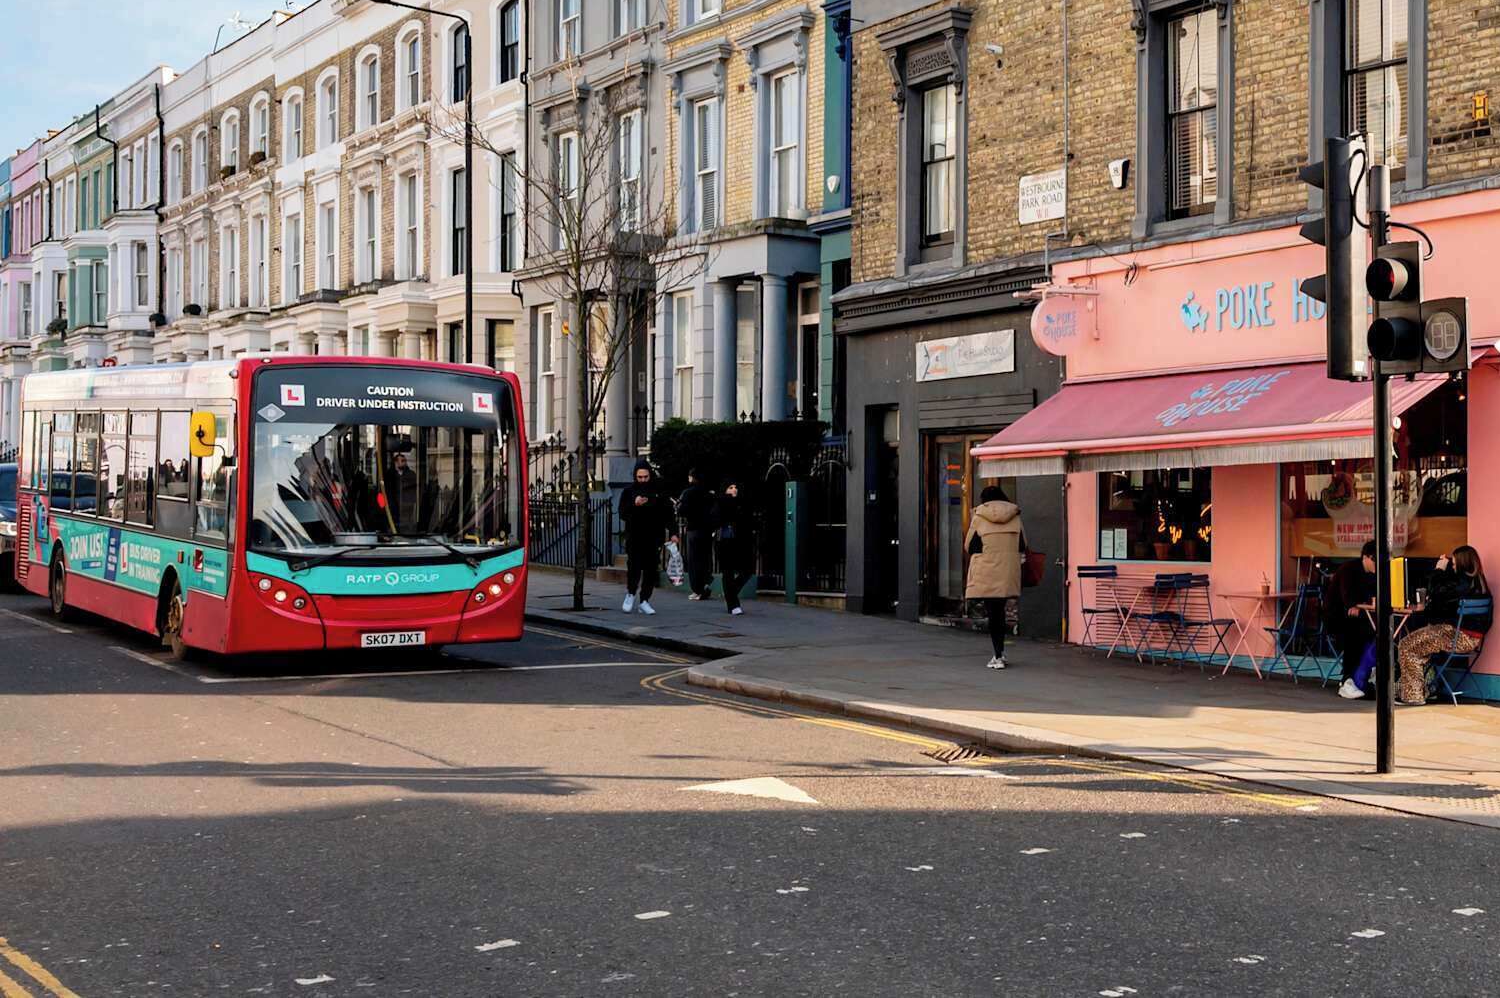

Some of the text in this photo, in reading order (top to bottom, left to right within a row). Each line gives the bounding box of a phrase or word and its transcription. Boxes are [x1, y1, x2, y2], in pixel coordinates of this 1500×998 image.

[1021, 178, 1064, 197] WESTBOURNE
[1021, 192, 1063, 210] PARK ROAD
[1216, 281, 1275, 331] POKE
[1056, 311, 1077, 325] POKE
[367, 386, 414, 396] CAUTION
[1212, 370, 1291, 398] POKE
[287, 389, 299, 401] L
[478, 396, 488, 408] L
[316, 397, 463, 412] DRIVER UNDER INSTRUCTION
[1155, 392, 1262, 427] HOUSE
[70, 535, 87, 561] JOIN
[89, 533, 104, 558] US!
[129, 543, 140, 559] BUS
[140, 545, 161, 564] DRIVER
[135, 563, 161, 584] TRAINING
[346, 573, 440, 584] RATP GROUP
[366, 633, 421, 645] SK07 DXT
